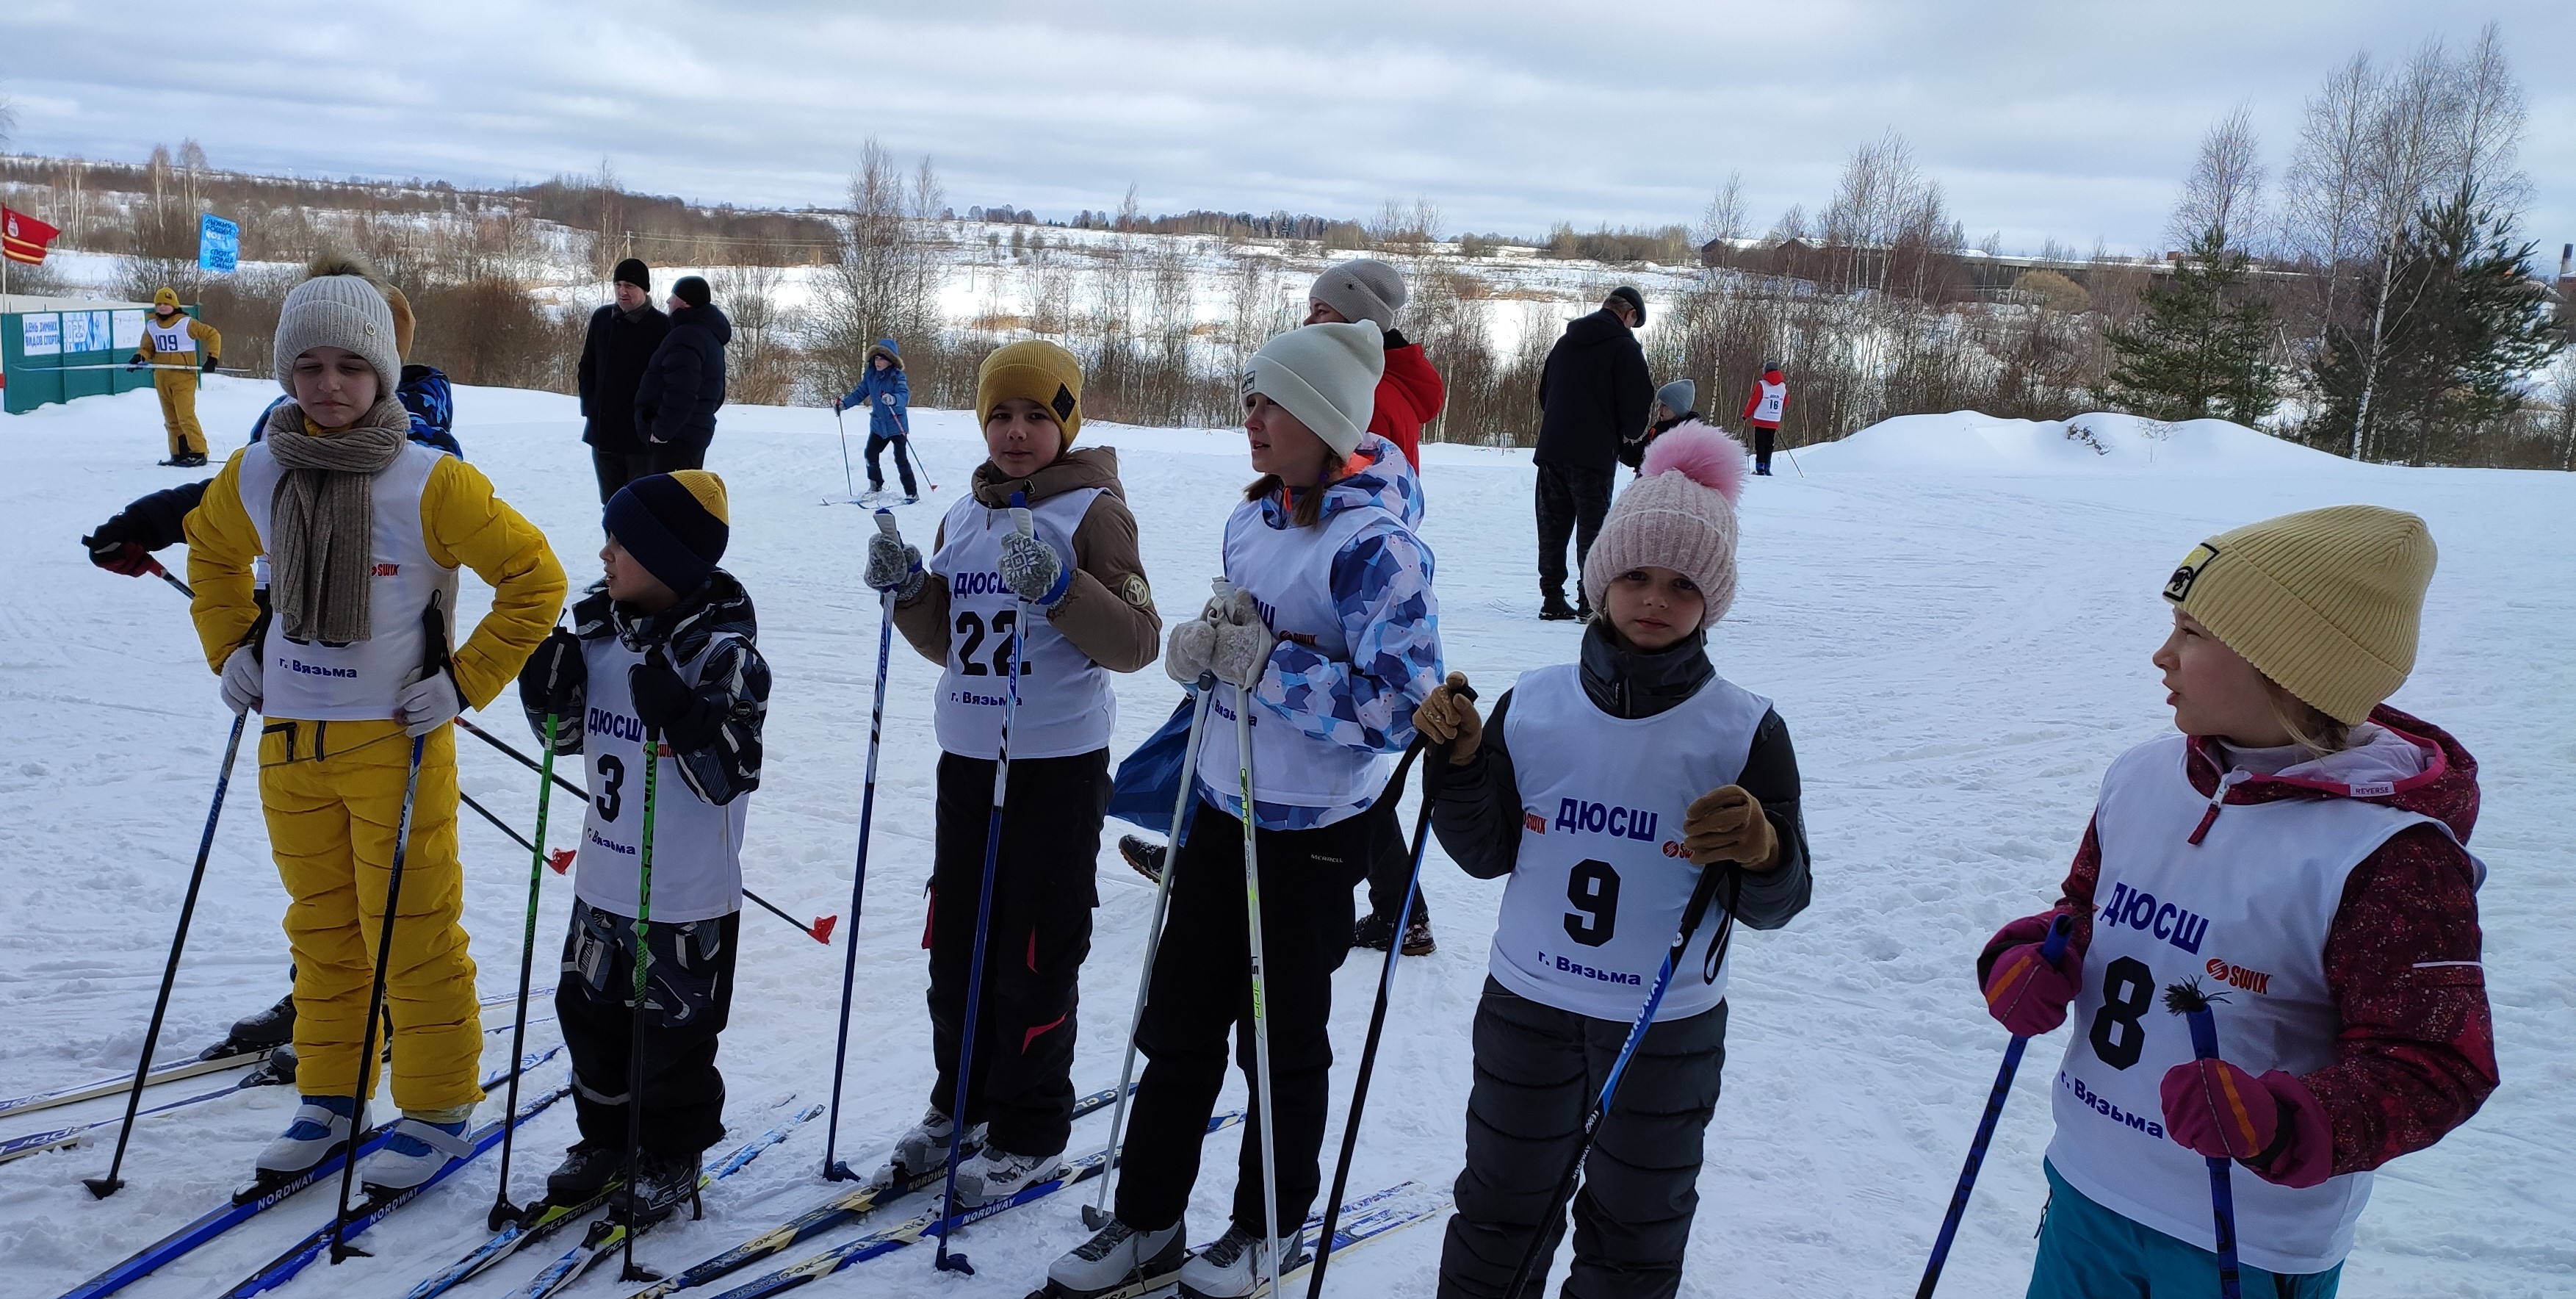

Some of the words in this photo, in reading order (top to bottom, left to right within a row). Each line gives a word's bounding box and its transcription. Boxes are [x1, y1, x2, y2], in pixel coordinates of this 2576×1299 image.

[25, 321, 39, 334] ДЕНЬ
[155, 334, 178, 351] 109
[377, 564, 400, 577] SWIX
[956, 610, 1032, 677] 22
[292, 659, 358, 678] Вязьма
[588, 707, 643, 743] ДЮСШ
[1214, 698, 1258, 727] Вязьа
[596, 753, 625, 824] 3
[2355, 786, 2389, 794] REVERSE
[1526, 813, 1548, 835] SWIX
[1555, 797, 1659, 843] ДЮСШ
[591, 829, 637, 856] Вязьма
[1563, 858, 1621, 948] 9
[2099, 882, 2209, 955] ДЮСШ
[1538, 951, 1551, 967] г.
[1556, 957, 1642, 986] Вязьма
[2229, 965, 2273, 995] SWIX
[2089, 955, 2156, 1071] 8
[2074, 1077, 2163, 1140] Вязьма
[907, 1166, 949, 1192] NORDWA
[1571, 1144, 1592, 1181] NORDWAY
[257, 1171, 315, 1212] NORDWAY
[369, 1187, 419, 1226] NORDWAY
[541, 1197, 604, 1235] PELTONEN
[962, 1197, 1016, 1225] NORDWAY
